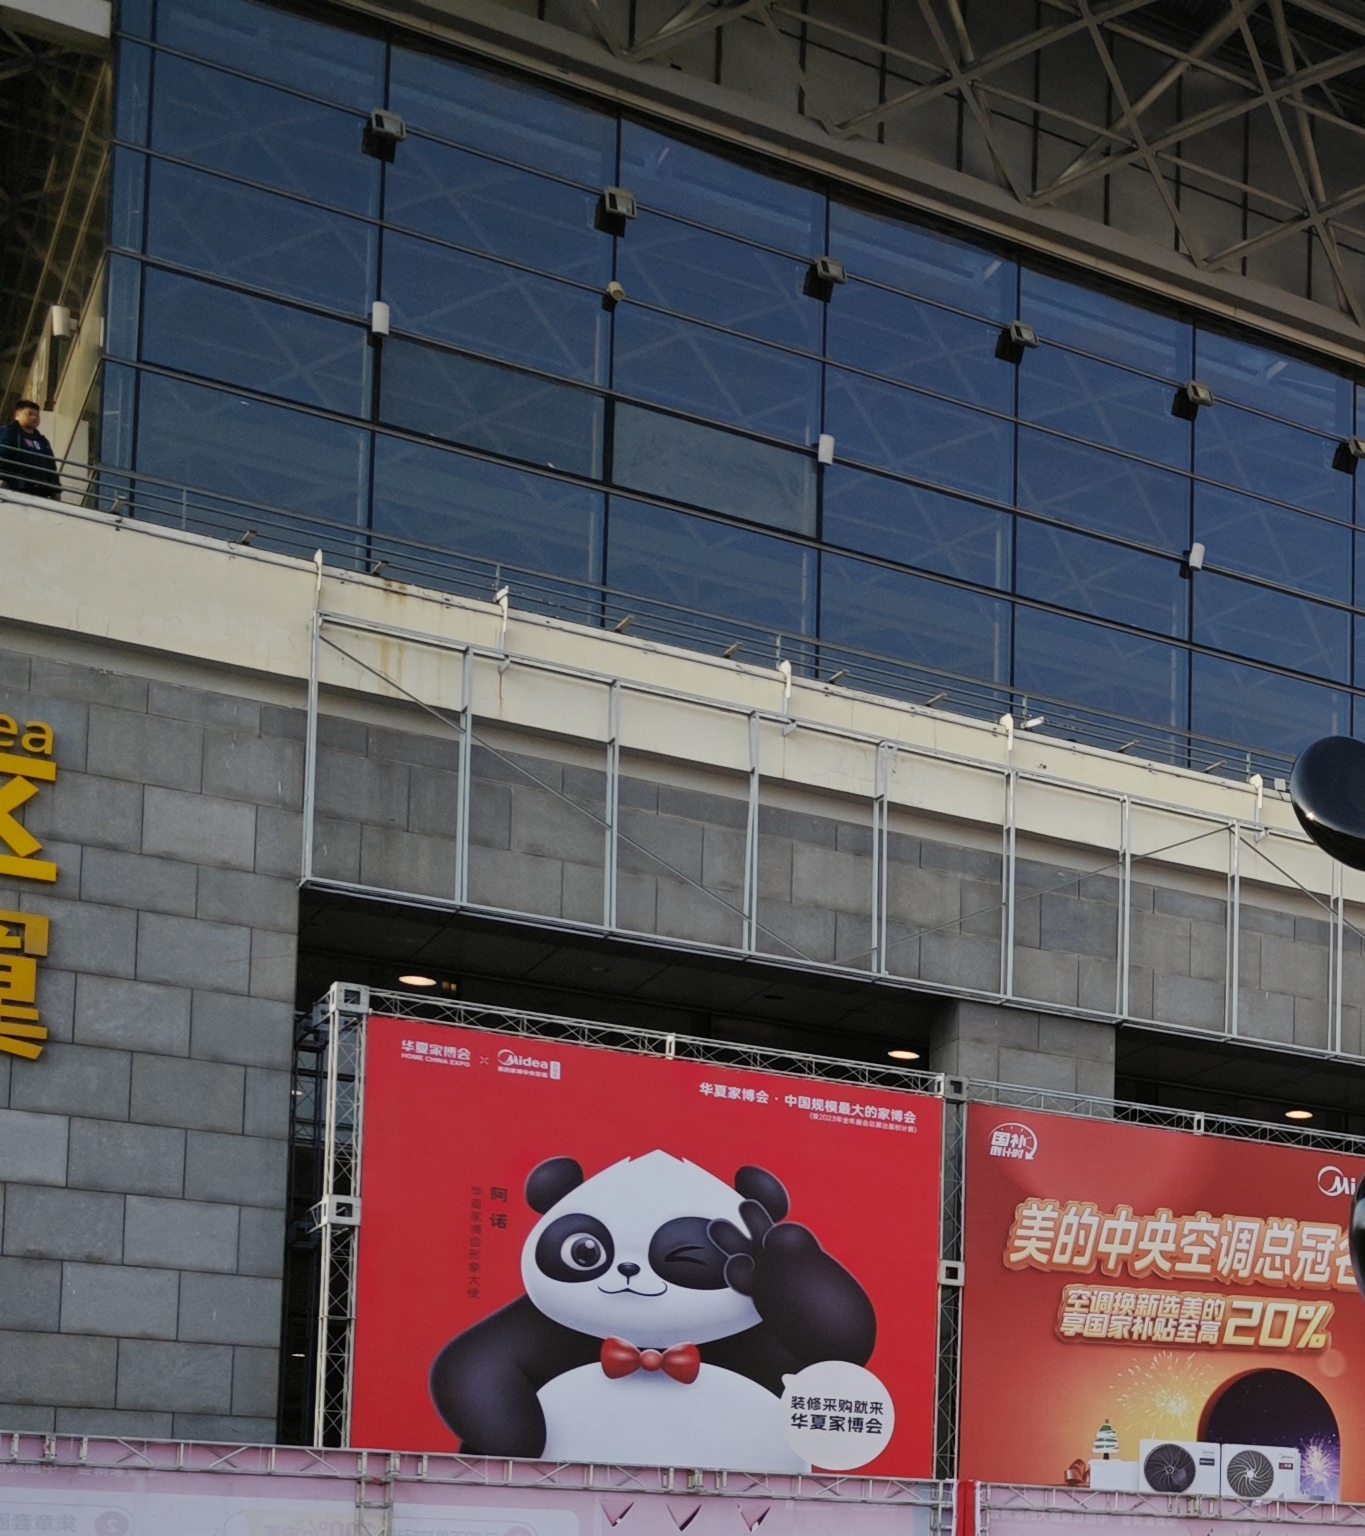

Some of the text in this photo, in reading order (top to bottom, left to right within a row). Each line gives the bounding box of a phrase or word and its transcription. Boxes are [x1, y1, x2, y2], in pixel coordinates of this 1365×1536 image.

[401, 1039, 471, 1061] 华夏家博会
[401, 1053, 471, 1068] HOME CHINA EXPO
[497, 1049, 549, 1070] Midea
[1063, 1288, 1227, 1322] 空调换新选美的
[790, 1395, 885, 1416] 装修采购就来
[790, 1412, 883, 1435] 华夏家博会
